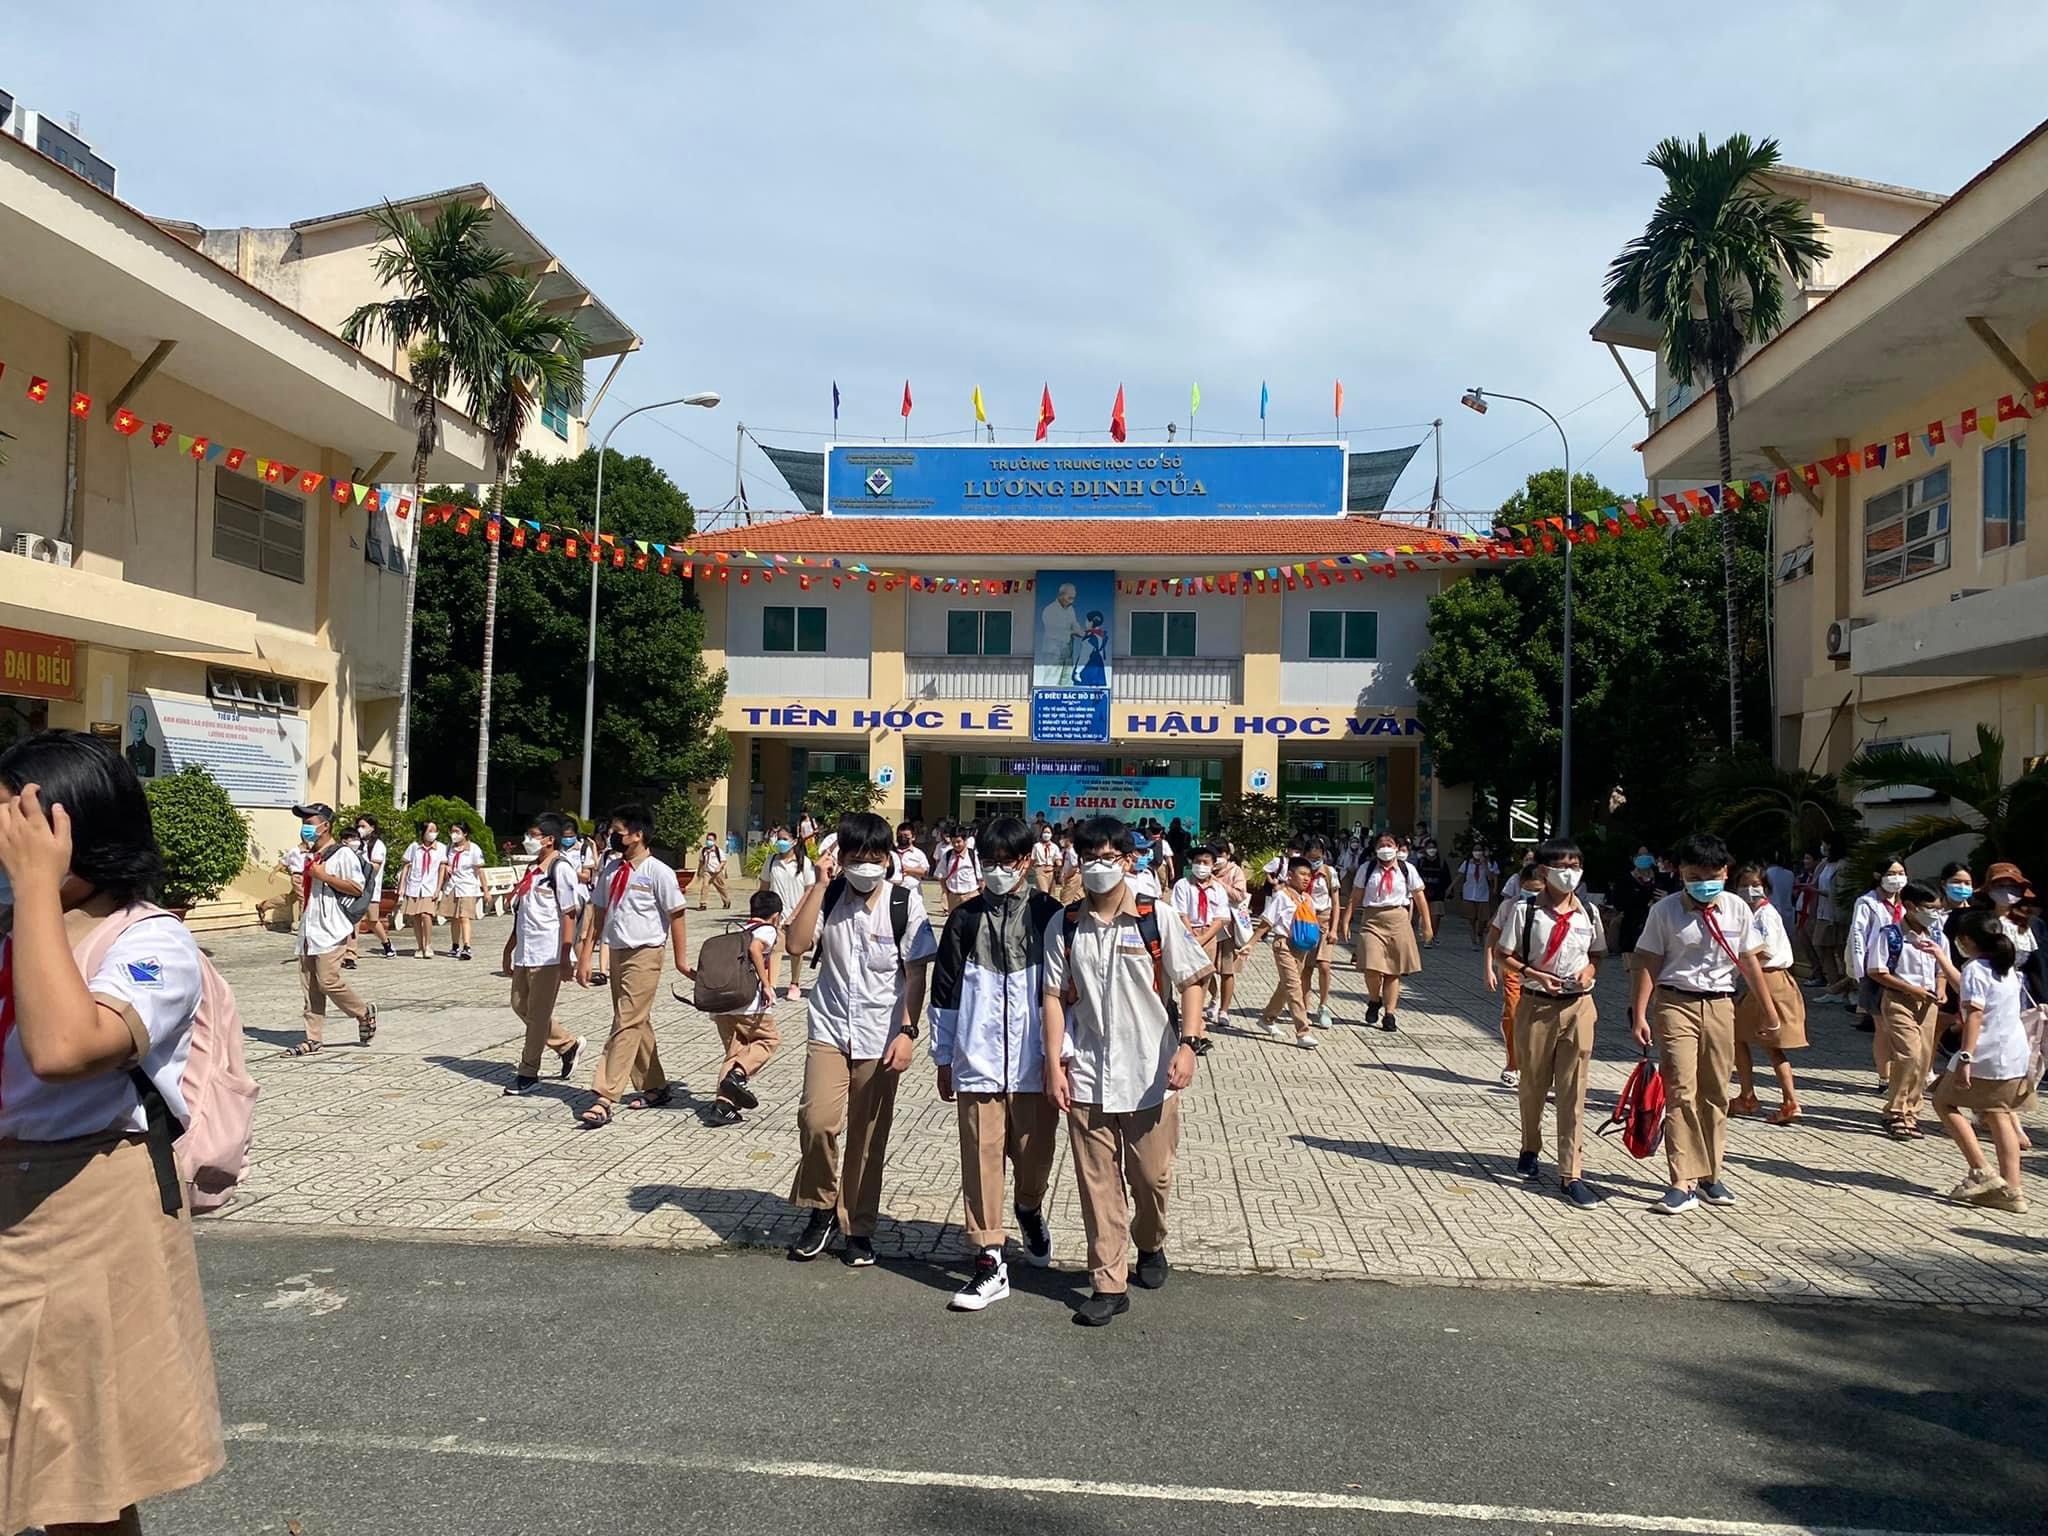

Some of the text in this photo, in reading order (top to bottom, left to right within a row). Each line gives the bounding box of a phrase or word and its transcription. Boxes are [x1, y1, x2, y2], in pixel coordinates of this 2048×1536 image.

[990, 456, 1050, 471] TRƯỜNG
[1055, 458, 1101, 470] TRUNG
[1105, 458, 1133, 472] HỌC
[964, 472, 1207, 501] LƯƠNG ĐỊNH CỦA
[4, 645, 70, 687] ĐẠI BIỂU
[741, 704, 1013, 732] TIÊN HỌC LỄ
[1127, 711, 1219, 737] HẬU
[1234, 716, 1331, 738] HỌC
[1076, 796, 1117, 809] KHAI
